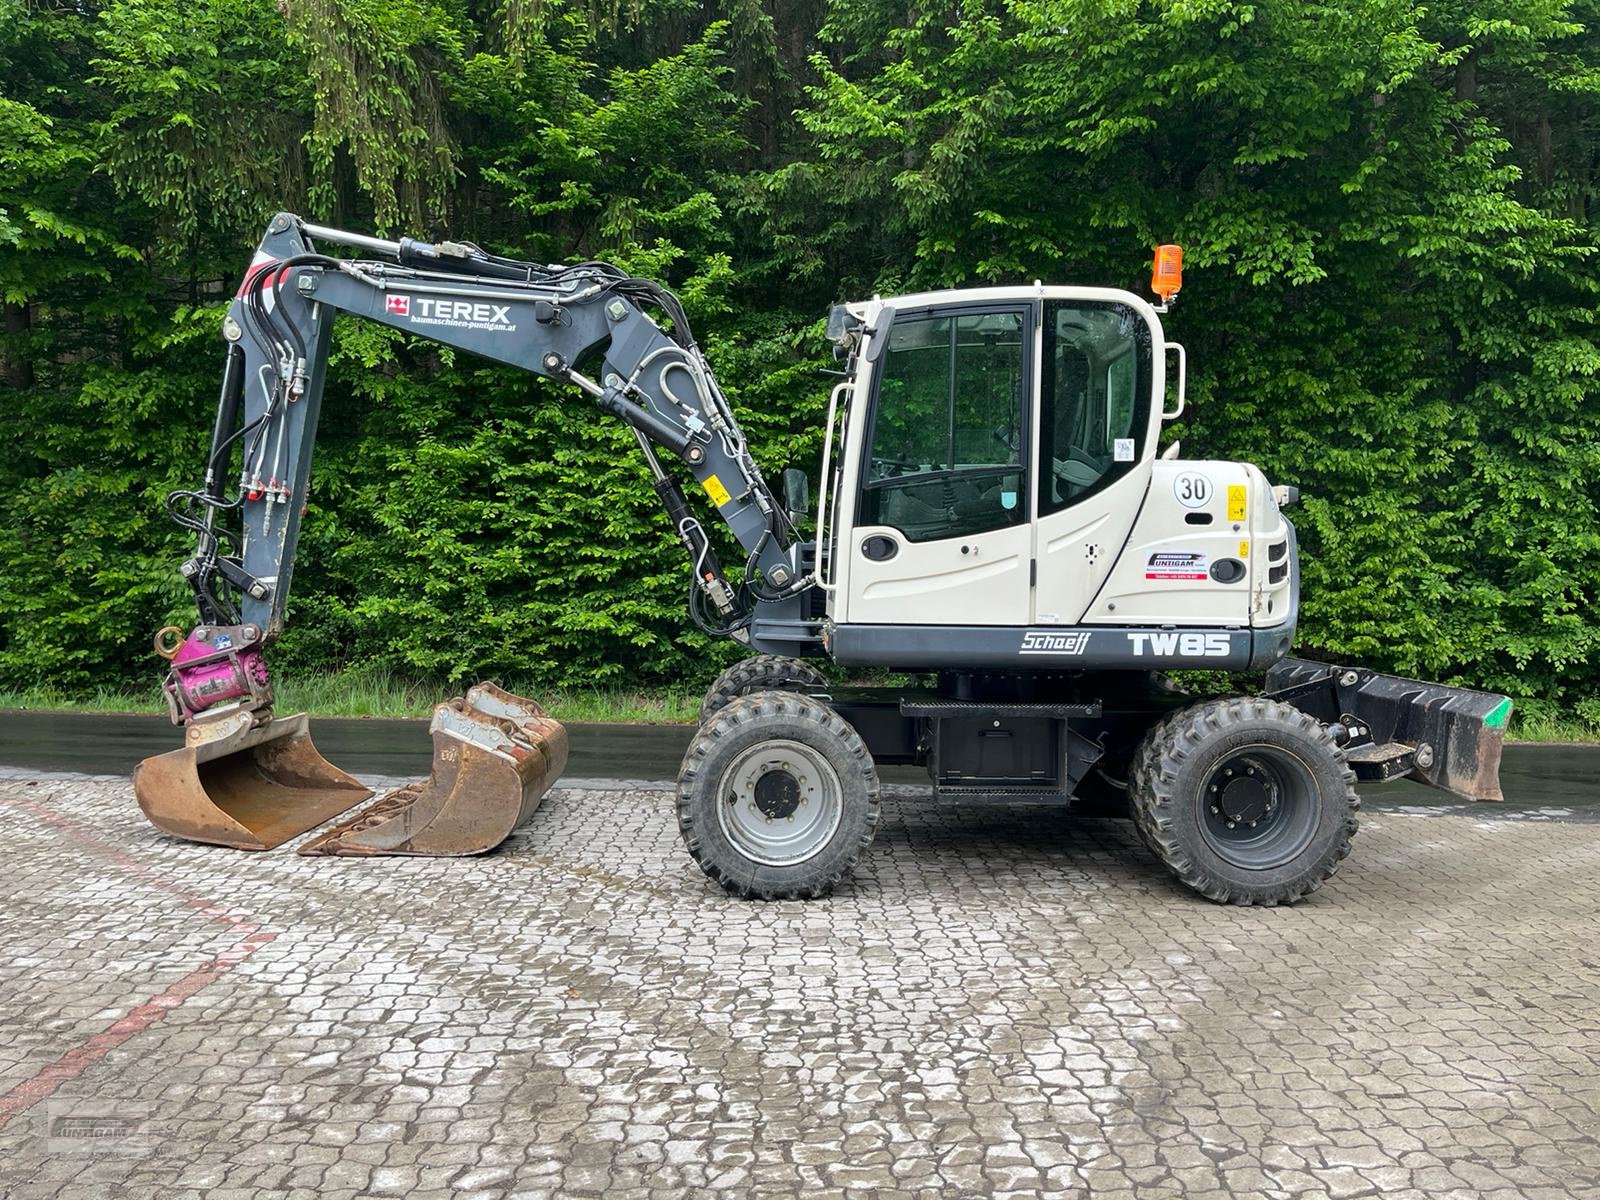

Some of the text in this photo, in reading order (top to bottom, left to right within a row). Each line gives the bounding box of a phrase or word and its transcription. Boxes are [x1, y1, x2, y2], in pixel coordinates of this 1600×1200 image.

[416, 298, 511, 324] TEREX
[411, 315, 517, 332] baumaschinen-puntigam.at
[1181, 477, 1206, 500] 30
[1019, 632, 1092, 655] Schaeff
[1127, 633, 1231, 656] TW85
